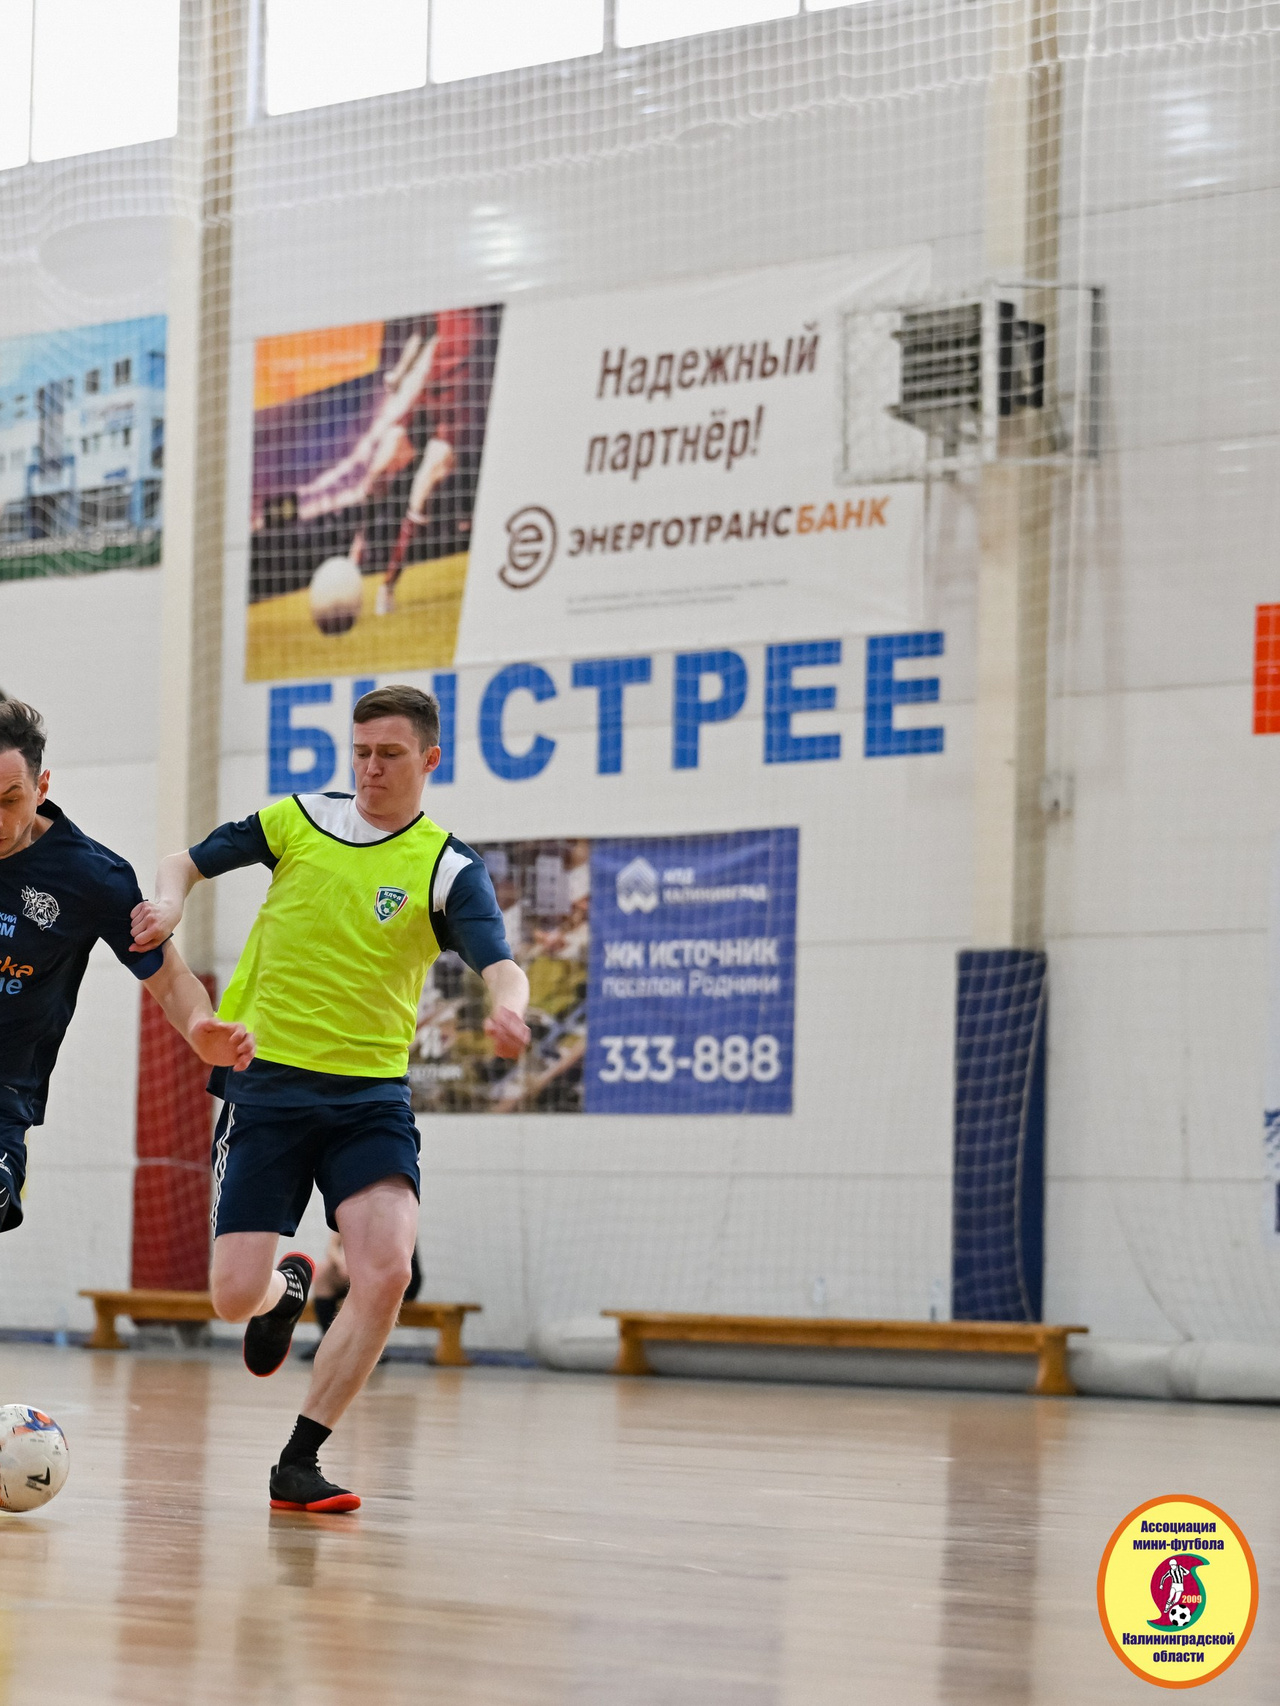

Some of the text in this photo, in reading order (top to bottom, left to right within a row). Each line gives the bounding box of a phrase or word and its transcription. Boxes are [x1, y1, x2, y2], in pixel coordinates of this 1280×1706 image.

[596, 320, 820, 402] Надежный
[584, 403, 765, 481] партнёр!
[567, 495, 893, 558] ЭНЕРГОТРАНСБАНК
[648, 936, 780, 970] ИСТОЧНИК
[598, 1034, 783, 1083] 333-888
